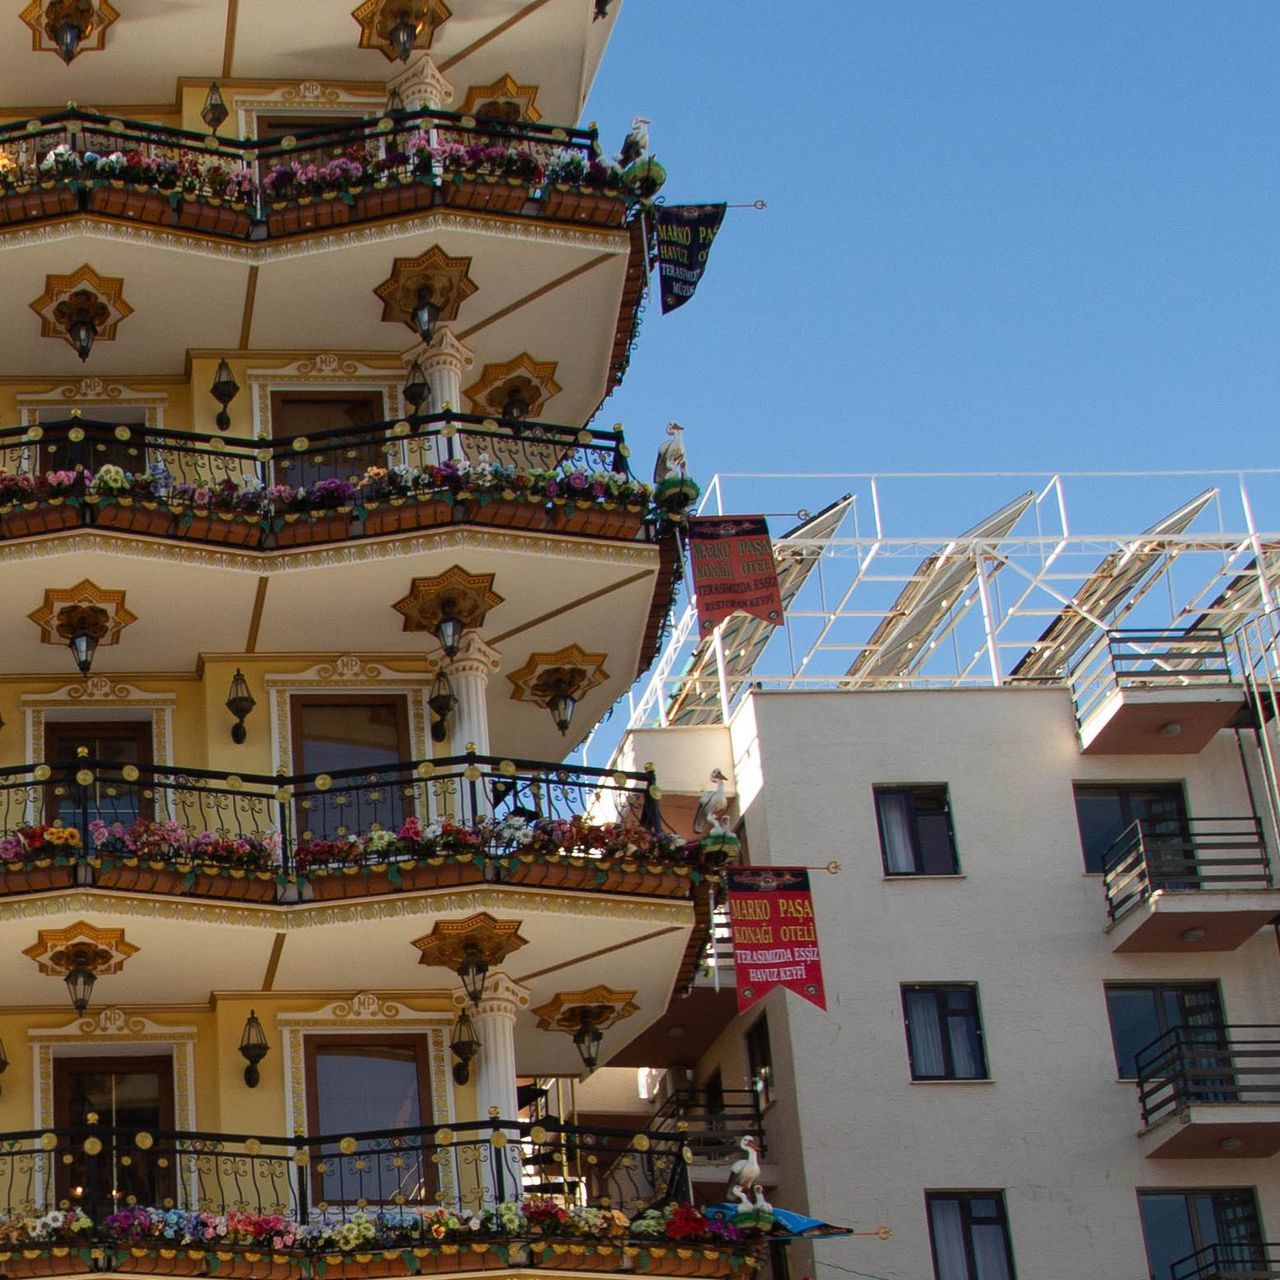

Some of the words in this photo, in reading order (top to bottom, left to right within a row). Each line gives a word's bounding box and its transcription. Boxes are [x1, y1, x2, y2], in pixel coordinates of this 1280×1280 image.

[731, 899, 770, 920] MARKO
[778, 899, 813, 923] PAŞA
[734, 923, 774, 943] KONAĞI
[781, 922, 815, 941] OTELİ
[735, 948, 792, 963] TERASIMIZDA
[749, 969, 779, 981] HAVUZ
[780, 963, 807, 980] KEYFİ
